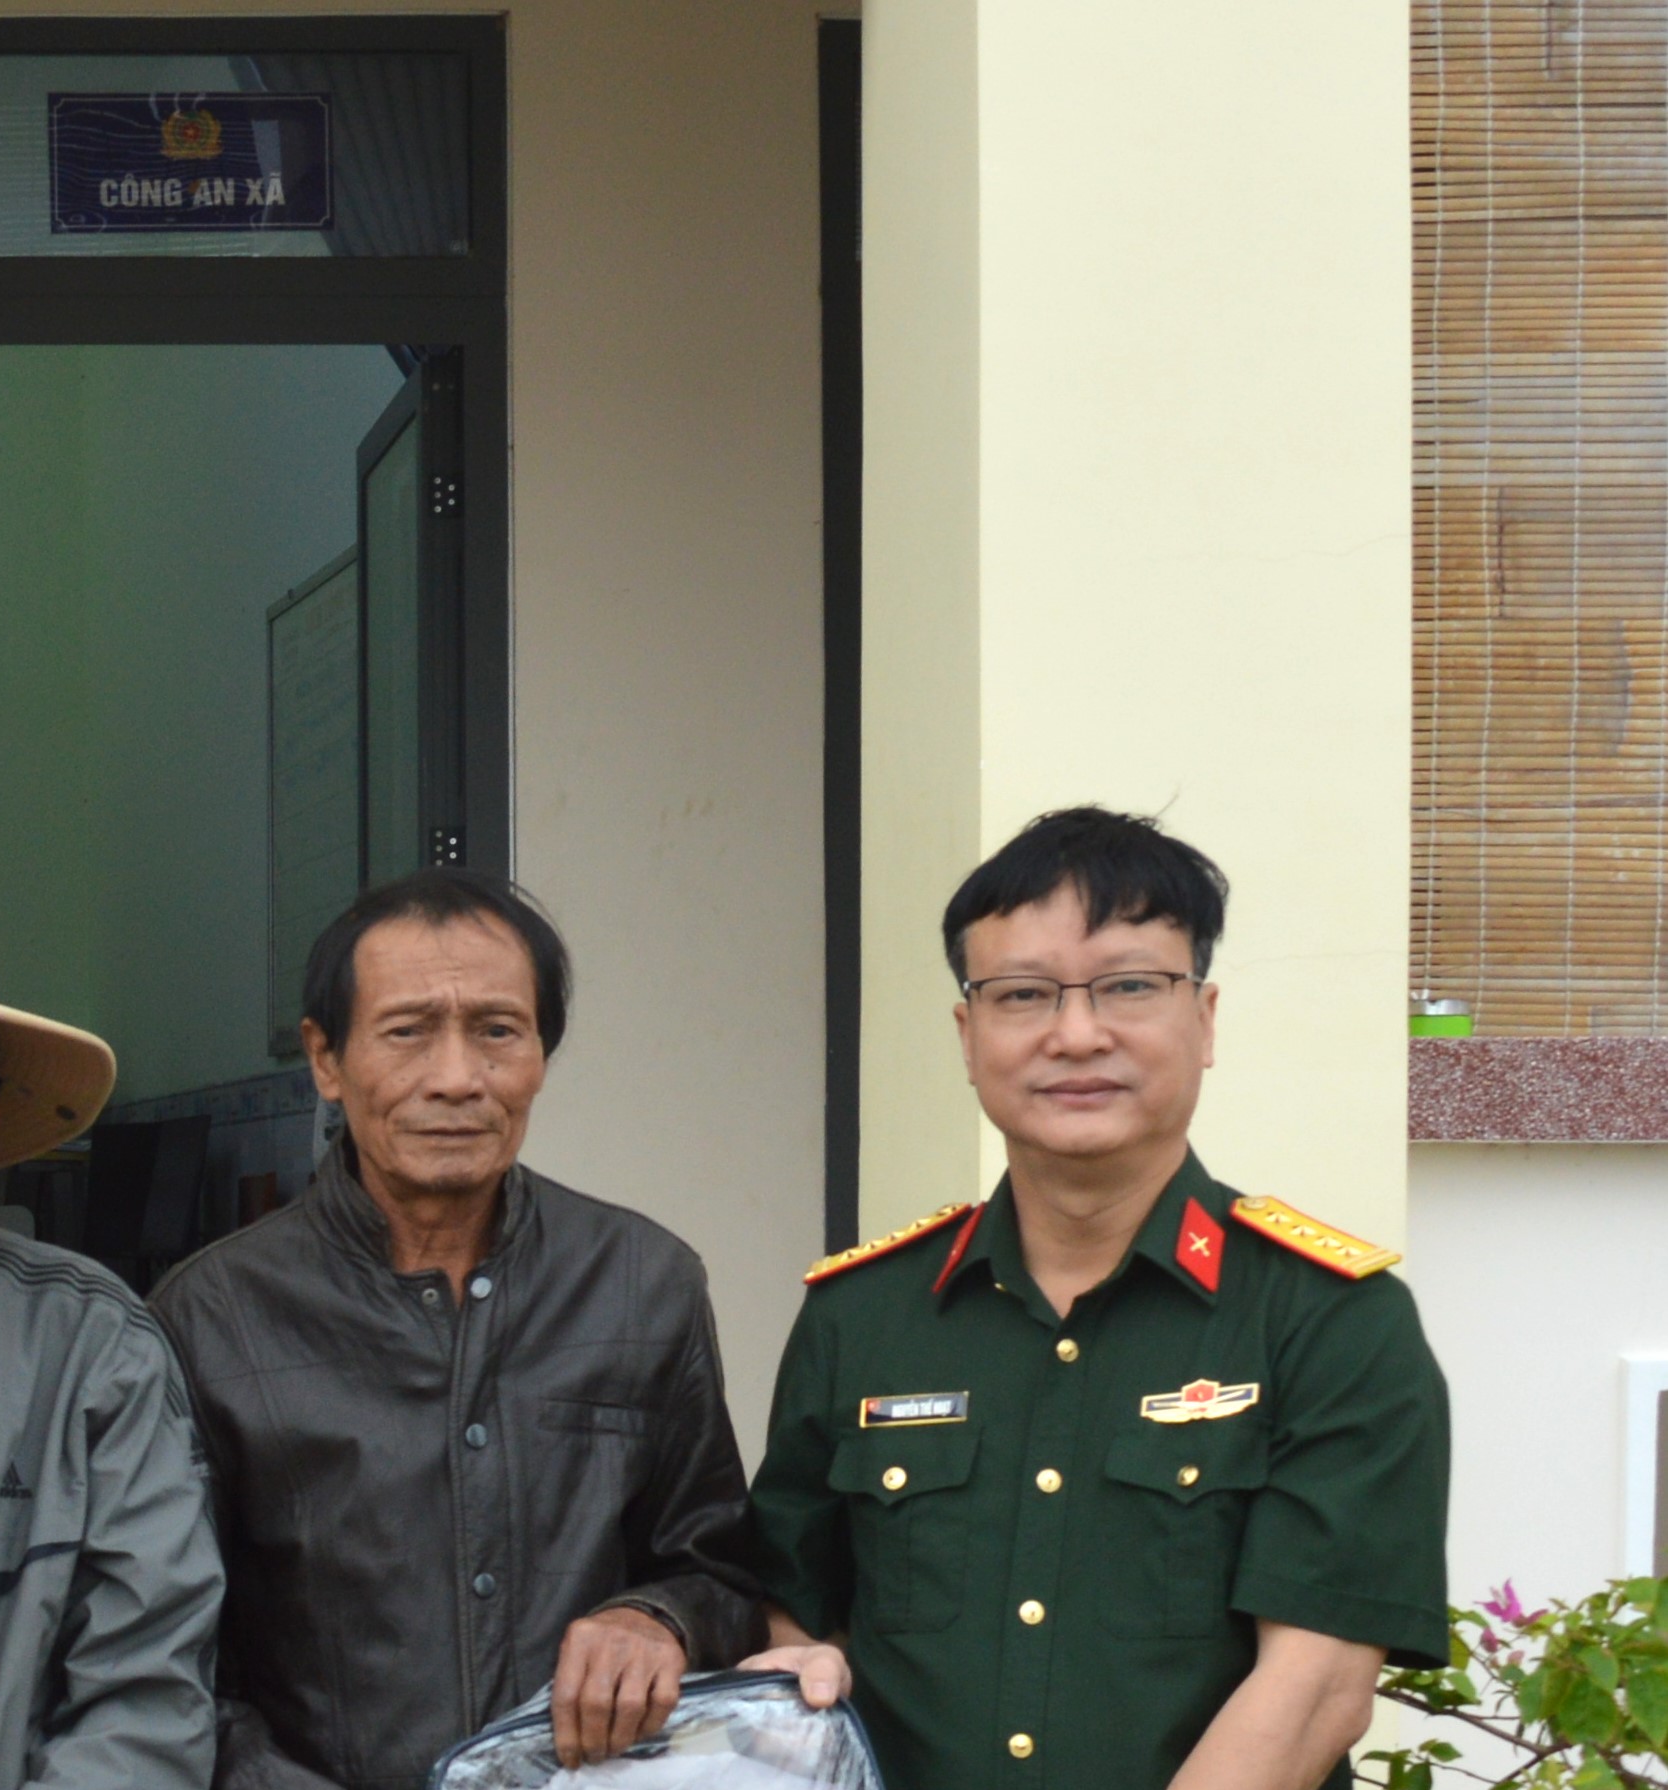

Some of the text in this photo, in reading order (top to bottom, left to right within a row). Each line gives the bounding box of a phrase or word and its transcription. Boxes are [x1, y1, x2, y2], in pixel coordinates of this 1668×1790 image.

[99, 172, 286, 207] CÔNG AN XÃ
